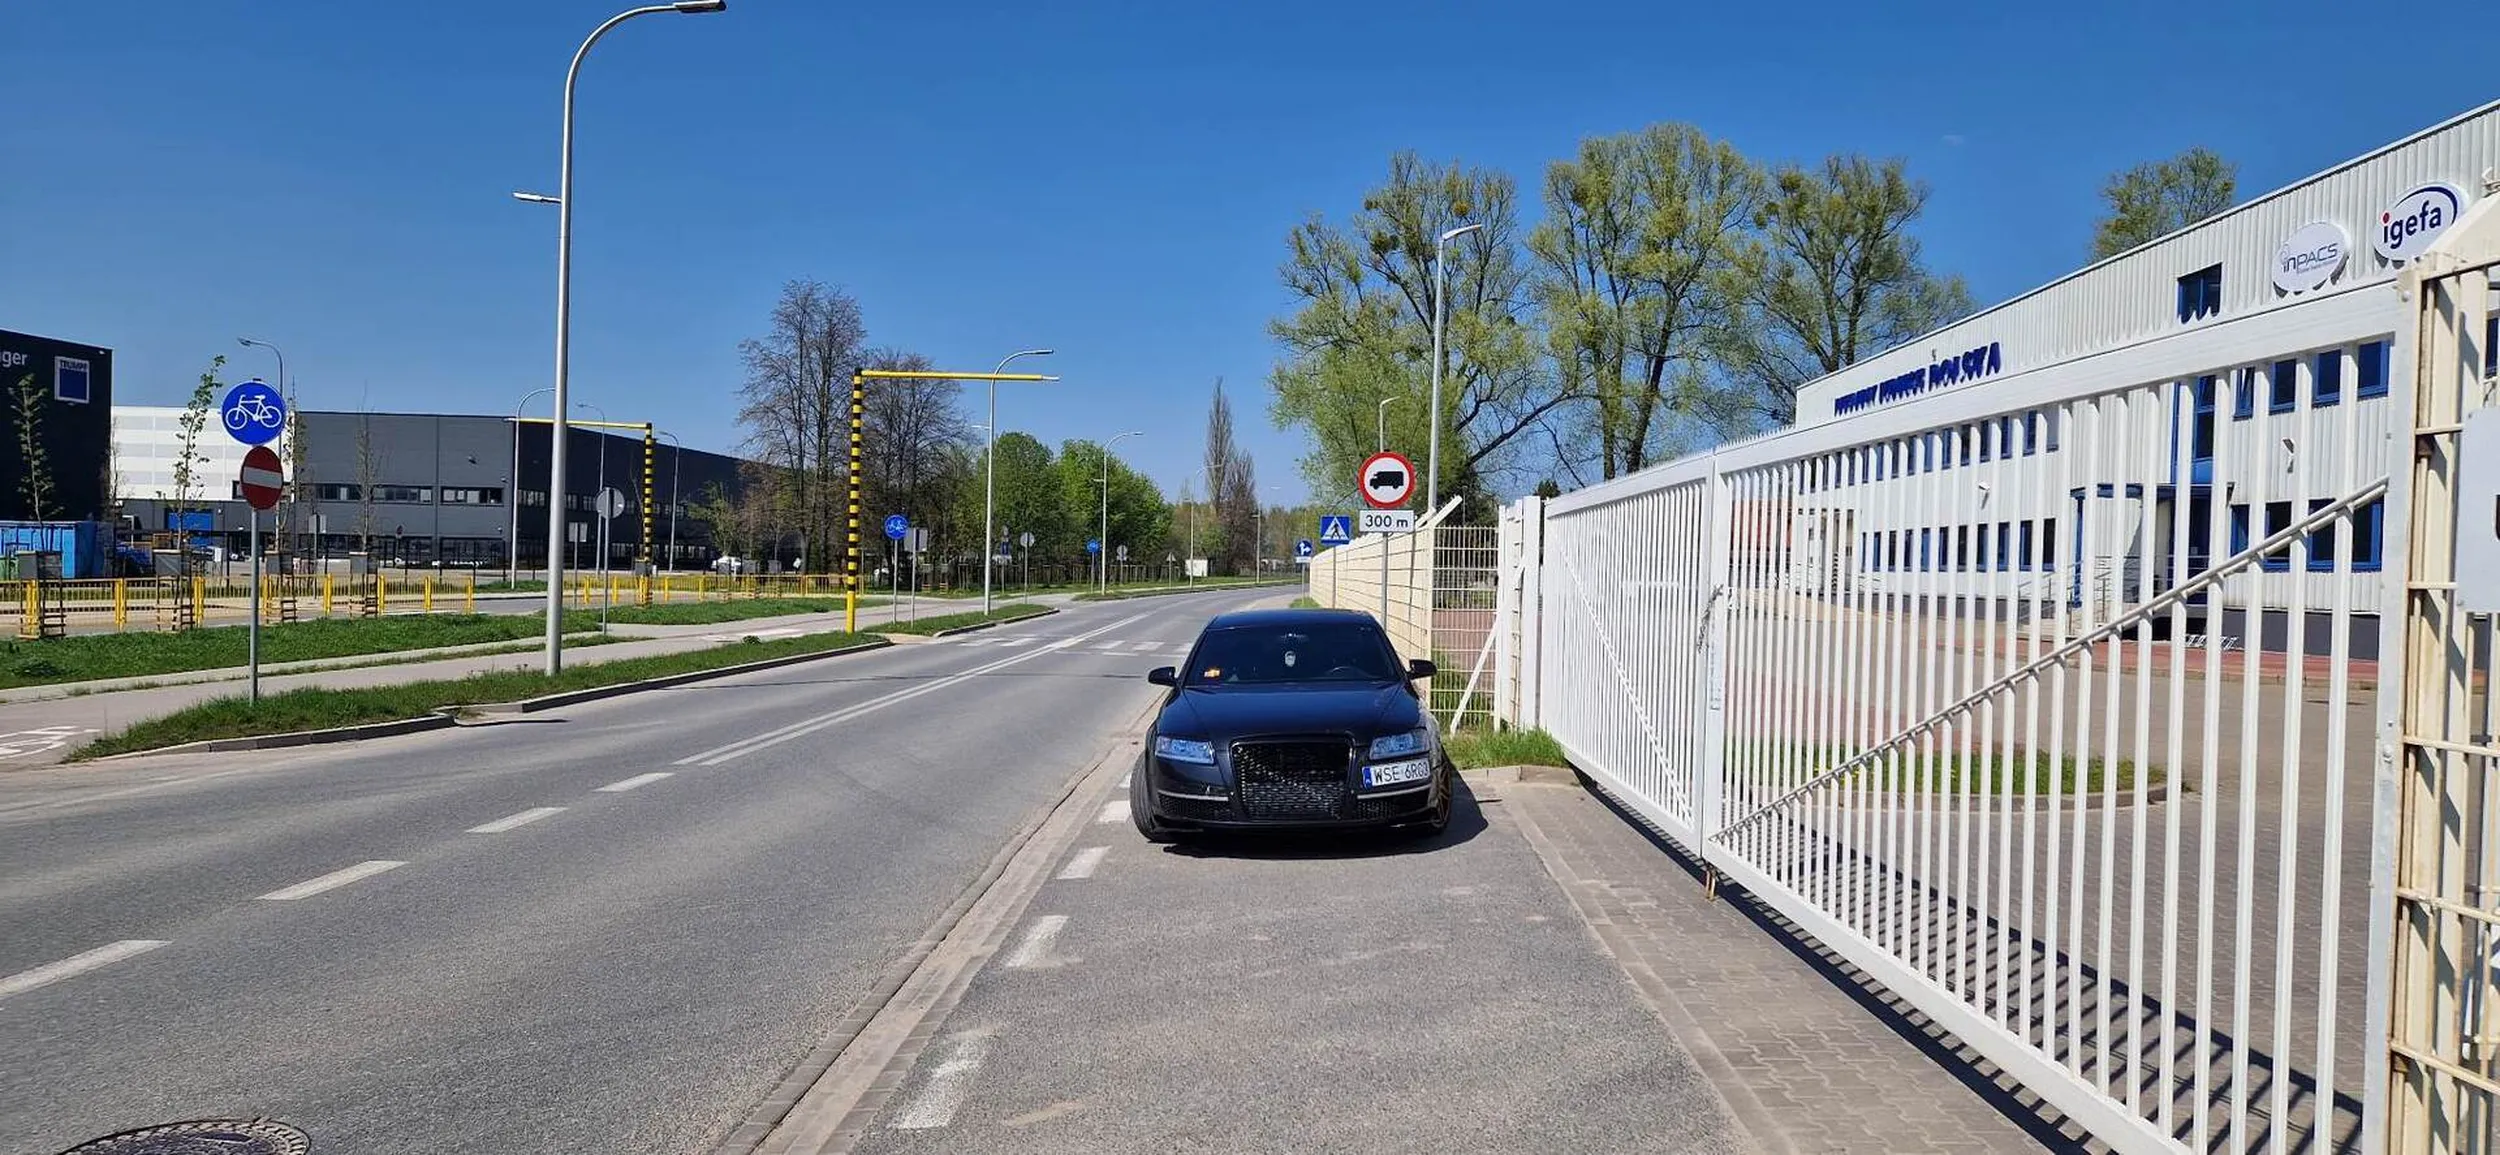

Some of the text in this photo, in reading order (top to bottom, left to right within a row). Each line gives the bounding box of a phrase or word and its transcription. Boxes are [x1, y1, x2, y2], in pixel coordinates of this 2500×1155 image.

[2382, 200, 2441, 249] igefa
[0, 351, 28, 367] ger
[1365, 515, 1408, 527] 300 m
[1374, 765, 1400, 783] WSE
